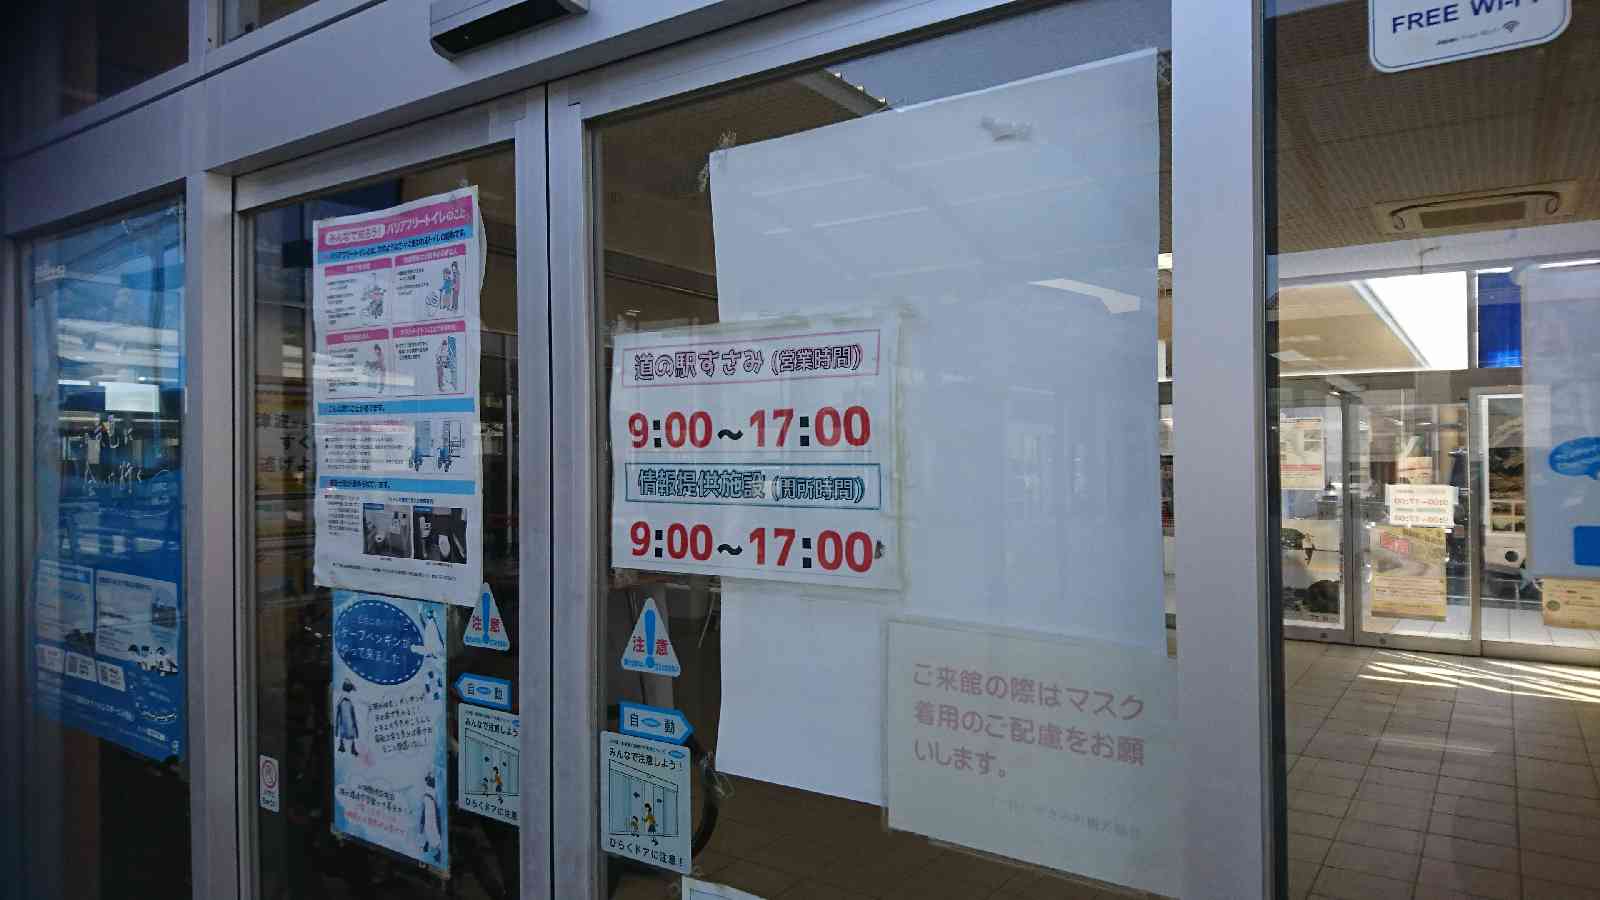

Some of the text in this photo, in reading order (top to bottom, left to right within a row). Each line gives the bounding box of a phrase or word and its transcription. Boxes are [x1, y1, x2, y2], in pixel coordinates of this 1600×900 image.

[1391, 0, 1538, 34] FREE WI-
[634, 344, 864, 381] 道の駅すさみ (営業時間)
[638, 468, 767, 499] 情報提供施設
[913, 663, 1145, 721] ご来館の際はマスク
[913, 700, 1145, 768] 着用のご配慮をお願
[914, 739, 1008, 778] いします。
